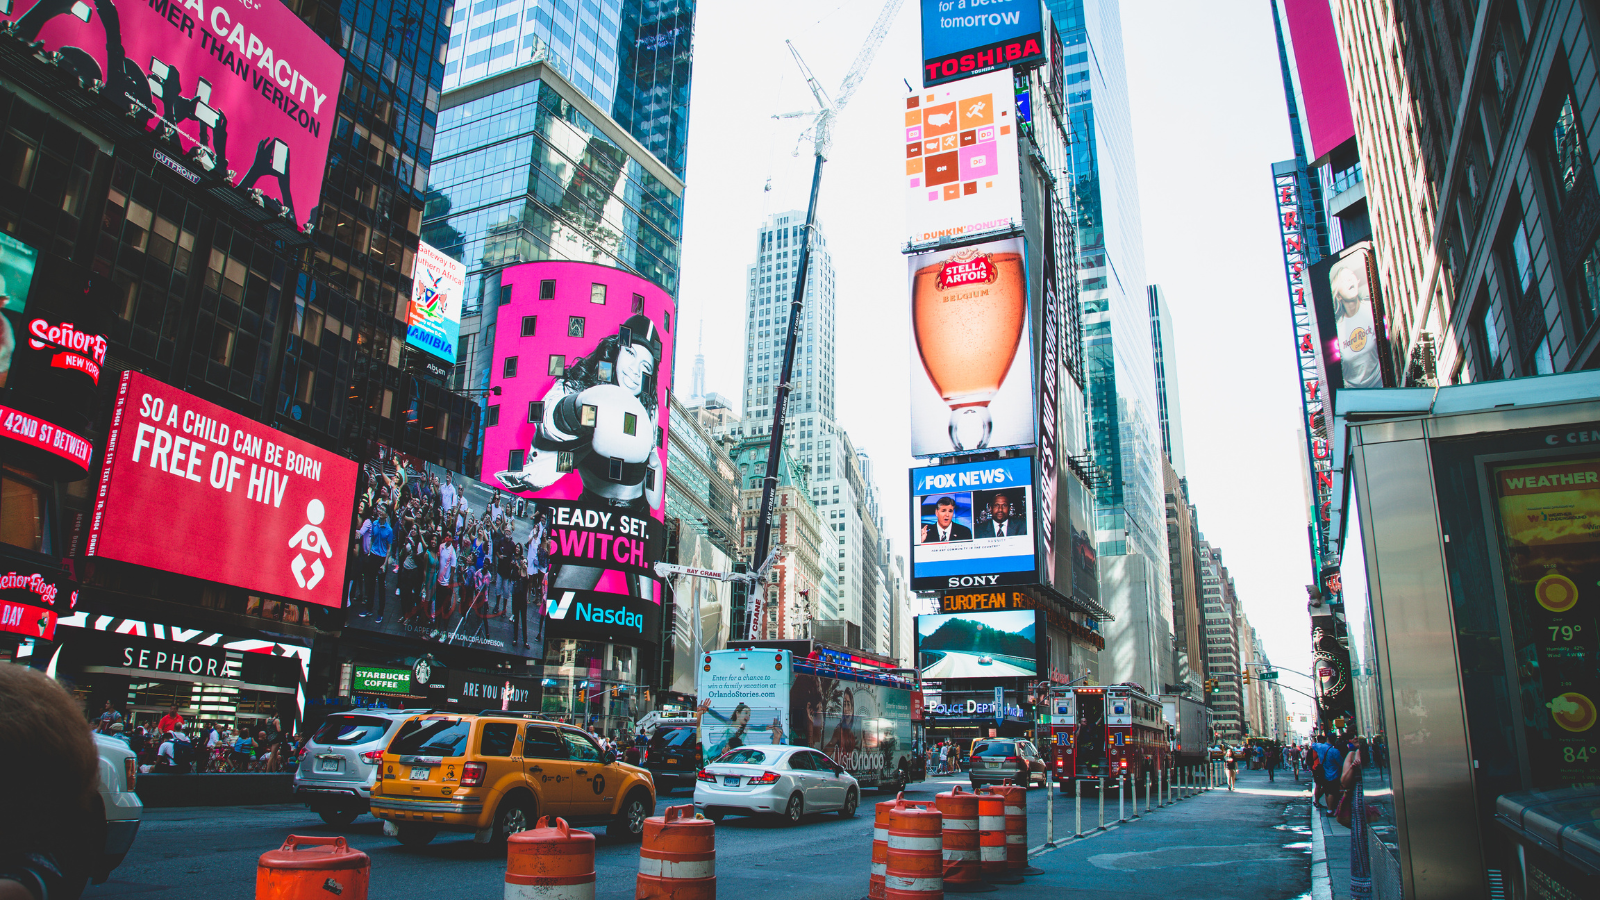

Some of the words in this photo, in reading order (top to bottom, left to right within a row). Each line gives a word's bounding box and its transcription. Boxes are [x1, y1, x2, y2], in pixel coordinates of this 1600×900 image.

[939, 1, 954, 12] for
[958, 1, 965, 9] a
[941, 11, 1020, 28] tomorrow
[149, 0, 195, 40] MER
[200, 27, 250, 82] THAN
[252, 70, 321, 138] VERIZON
[210, 6, 327, 114] CAPACITY
[926, 39, 1040, 79] TOSHIBA
[971, 66, 994, 74] TOSHIBA
[155, 152, 198, 182] OUTFRONT
[924, 226, 966, 240] DUNKIN'
[967, 218, 1009, 232] DONUTS
[1282, 186, 1304, 304] ERNST
[418, 244, 448, 268] Gateway
[449, 261, 456, 271] to
[418, 257, 440, 273] uthern
[946, 262, 986, 275] STELLA
[946, 270, 987, 284] ARTOIS
[942, 289, 989, 303] BELGIUM
[407, 324, 452, 355] NAMIBIA
[1343, 333, 1357, 349] Hard
[1358, 326, 1372, 340] Rock
[66, 355, 84, 368] NEW
[85, 360, 100, 379] YORK
[427, 364, 446, 376] Absen
[4, 412, 38, 438] 42ND
[39, 424, 54, 444] ST
[53, 429, 88, 461] BETWEEN
[140, 394, 164, 422] SO
[166, 404, 178, 425] A
[182, 410, 230, 447] CHILD
[233, 429, 263, 459] CAN
[265, 441, 284, 465] BE
[286, 450, 322, 481] BORN
[132, 422, 206, 483] FREE
[210, 450, 245, 493] OF
[247, 468, 288, 509] HIV
[925, 473, 957, 490] FOX
[958, 468, 1005, 486] NEWS
[1506, 471, 1599, 490] WEATHER
[550, 507, 615, 531] READY.
[620, 515, 649, 539] SET.
[550, 528, 649, 568] SWITCH.
[0, 572, 30, 588] eñor
[30, 573, 58, 604] Frog's
[949, 575, 1000, 588] SONY
[944, 592, 1005, 610] EUROPEAN
[1, 605, 24, 626] DAY
[575, 602, 643, 633] Nasdaq
[752, 599, 761, 631] CRANE
[1548, 625, 1581, 641] 79°
[123, 647, 232, 677] SEPHORA
[356, 670, 410, 681] STARBUCKS
[364, 679, 398, 688] COFFEE
[463, 682, 479, 698] ARE
[482, 685, 498, 699] YOU
[500, 687, 529, 703] RADY?
[930, 701, 964, 714] POLICE
[966, 700, 992, 713] DEPT
[1057, 732, 1070, 746] R
[1115, 732, 1124, 746] 1
[851, 749, 884, 770] Orlando
[1562, 746, 1598, 763] 84°
[596, 778, 602, 792] T
